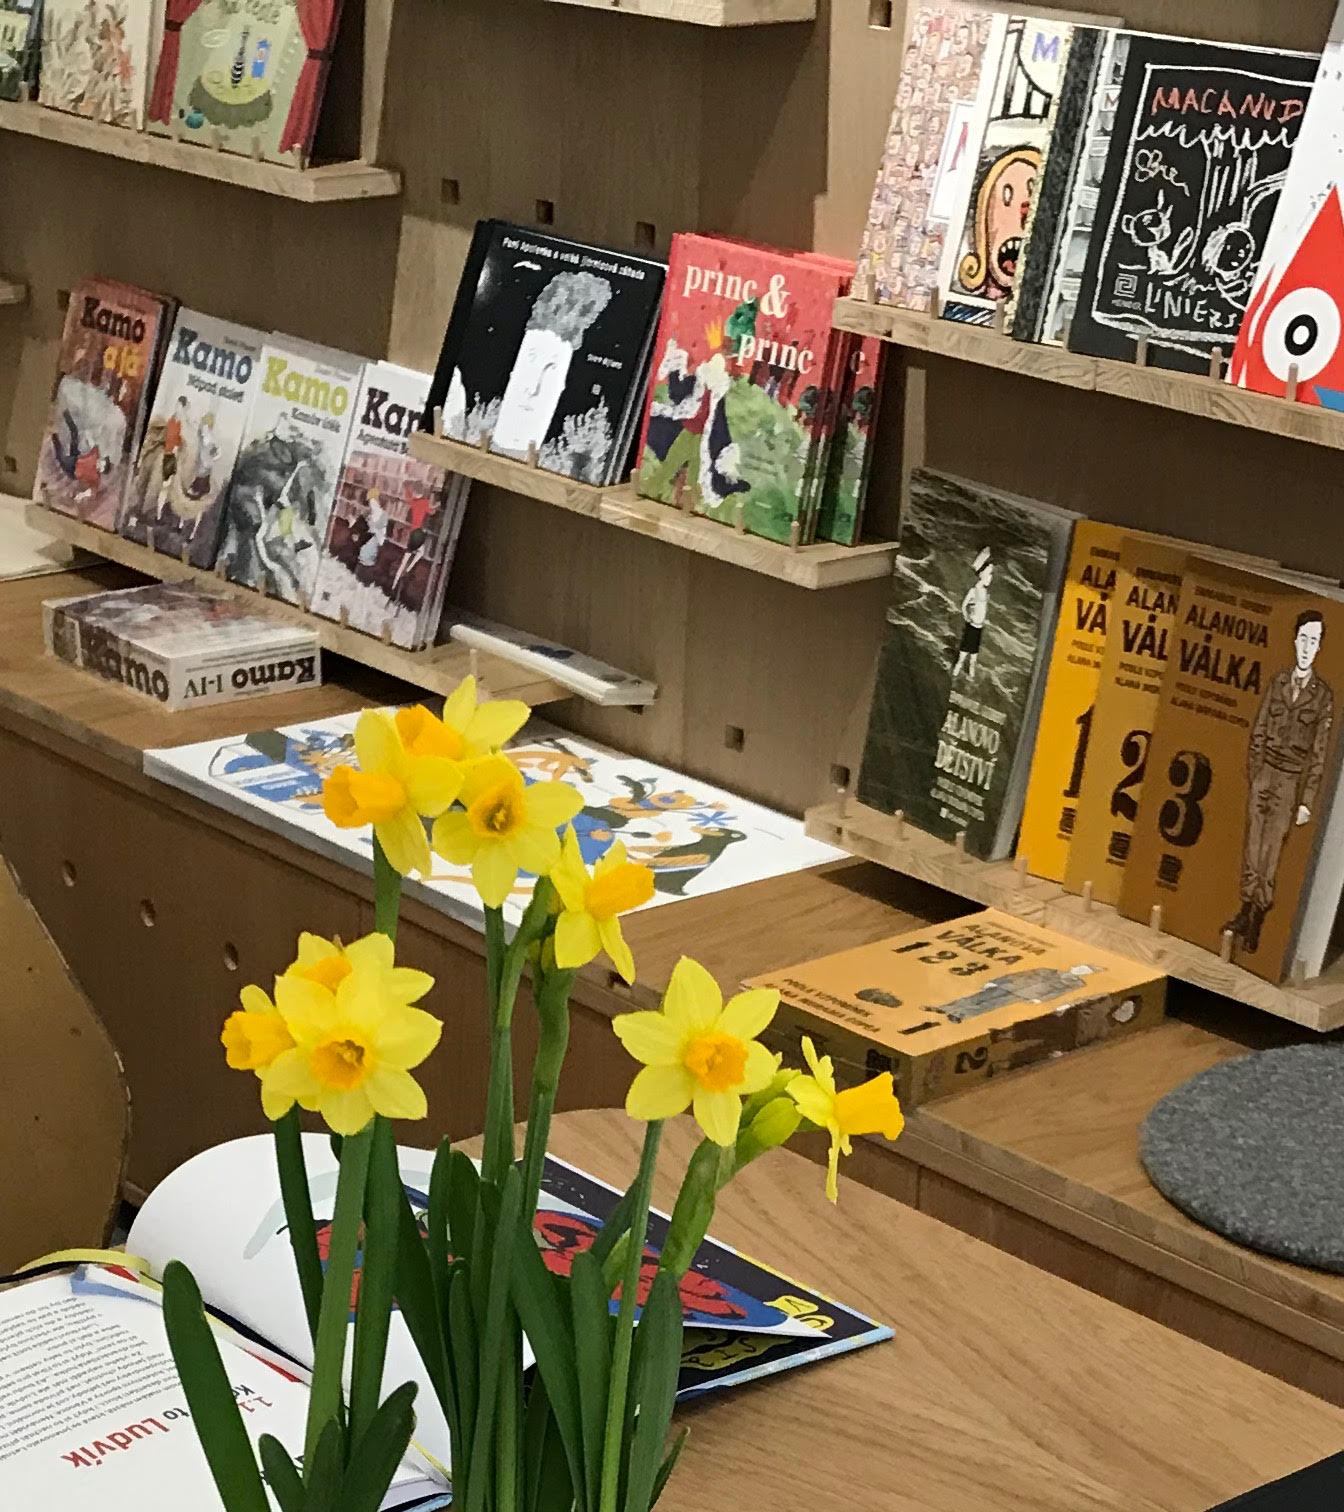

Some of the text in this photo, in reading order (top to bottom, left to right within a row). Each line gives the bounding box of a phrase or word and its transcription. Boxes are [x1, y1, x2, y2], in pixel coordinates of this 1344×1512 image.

[1152, 86, 1305, 124] MACANUD
[682, 263, 790, 318] princ &
[80, 296, 146, 344] Kamo
[171, 326, 253, 385] Kamo
[735, 334, 814, 374] princ
[261, 356, 349, 416] Kamo
[1184, 604, 1269, 648] ALANOVA
[183, 674, 224, 699] I-IV
[231, 655, 316, 690] Kamo
[1179, 634, 1262, 695] VÁLKA
[1158, 750, 1212, 847] 3
[935, 929, 1023, 966] VÁLKA
[962, 924, 1046, 957] ALANOVA
[60, 1417, 170, 1468] Ludvík
